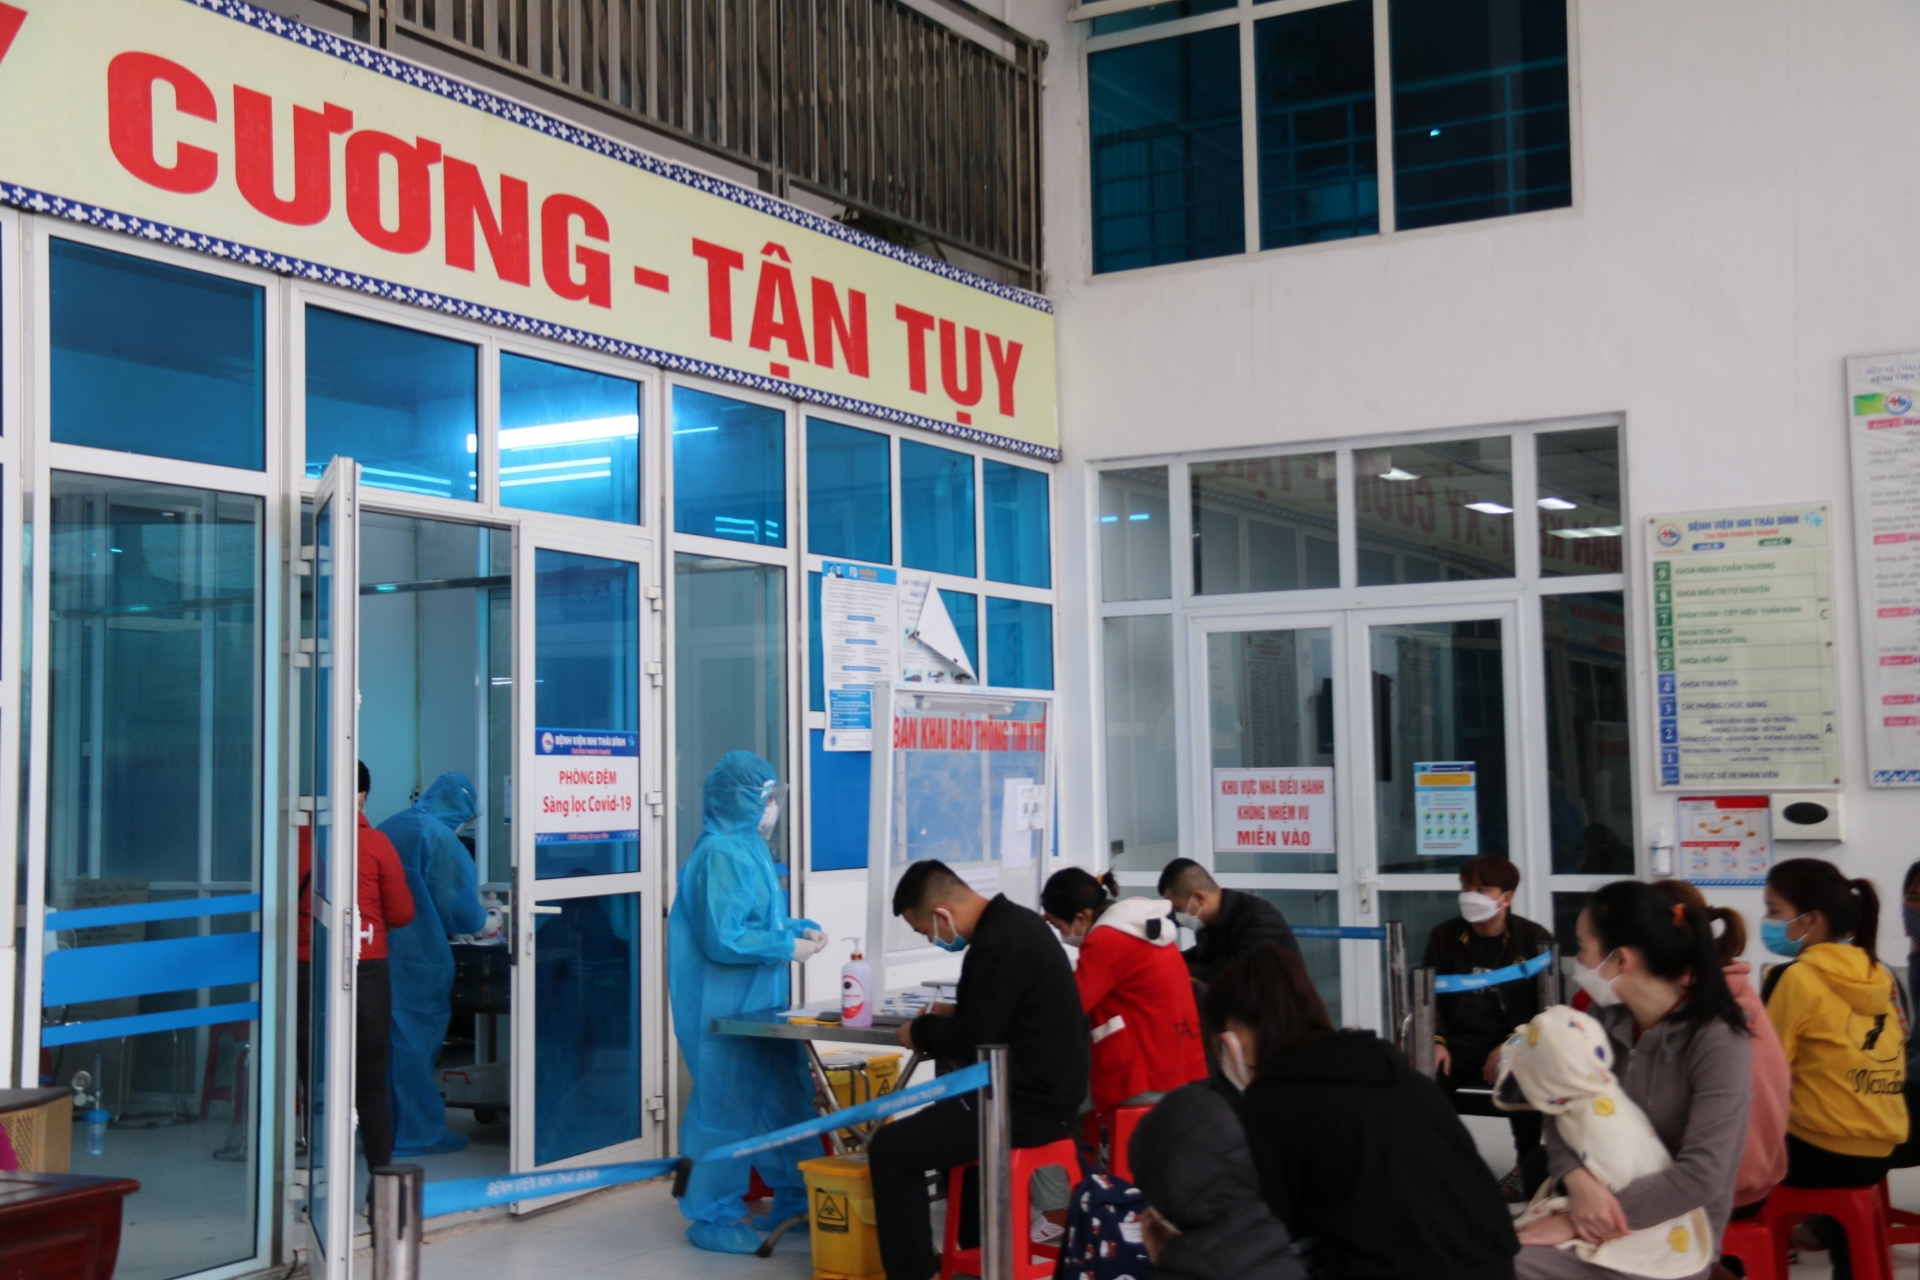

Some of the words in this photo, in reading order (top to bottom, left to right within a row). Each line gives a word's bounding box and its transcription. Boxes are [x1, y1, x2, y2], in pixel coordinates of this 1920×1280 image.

[108, 51, 611, 308] CƯƠNG
[634, 266, 669, 293] -
[692, 237, 870, 379] TẬN
[895, 304, 1023, 425] TỤY
[1688, 521, 1711, 532] BỆNH
[1714, 519, 1733, 530] VIỆN
[1737, 519, 1751, 527] NHI
[1755, 516, 1773, 526] THÁI
[1777, 515, 1799, 525] BÌNH
[1659, 570, 1666, 580] 9
[1659, 592, 1667, 602] 8
[1677, 589, 1696, 597] KHOA
[1661, 615, 1668, 624] 7
[1820, 609, 1828, 620] C
[1661, 637, 1668, 647] 6
[1662, 659, 1669, 670] 5
[1663, 682, 1670, 692] 4
[1664, 705, 1671, 715] 3
[894, 709, 917, 749] BÀN
[921, 717, 947, 749] KHAI
[951, 712, 972, 750] BÁO
[975, 714, 1008, 751] THÔNG
[1012, 722, 1027, 751] TIN
[1825, 723, 1833, 734] A
[1665, 729, 1672, 740] 2
[555, 734, 572, 747] BỆNH
[573, 734, 586, 747] VIỆN
[587, 737, 597, 745] NHI
[598, 735, 611, 746] THÁI
[612, 735, 626, 747] BÌNH
[1667, 753, 1672, 763] 1
[560, 768, 594, 784] PHÒNG
[596, 768, 616, 789] ĐỆM
[1221, 780, 1238, 794] KHU
[1241, 779, 1256, 798] VỰC
[1259, 777, 1276, 794] NHÀ
[1301, 776, 1324, 794] HÀNH
[543, 795, 569, 817] Sàng
[572, 795, 586, 817] lọc
[589, 795, 631, 811] Covid-19
[1237, 802, 1265, 820] KHÔNG
[1268, 802, 1295, 824] NHIỆM
[1298, 805, 1309, 824] VỤ
[1237, 824, 1276, 845] MIỄN
[1281, 827, 1310, 845] VÀO
